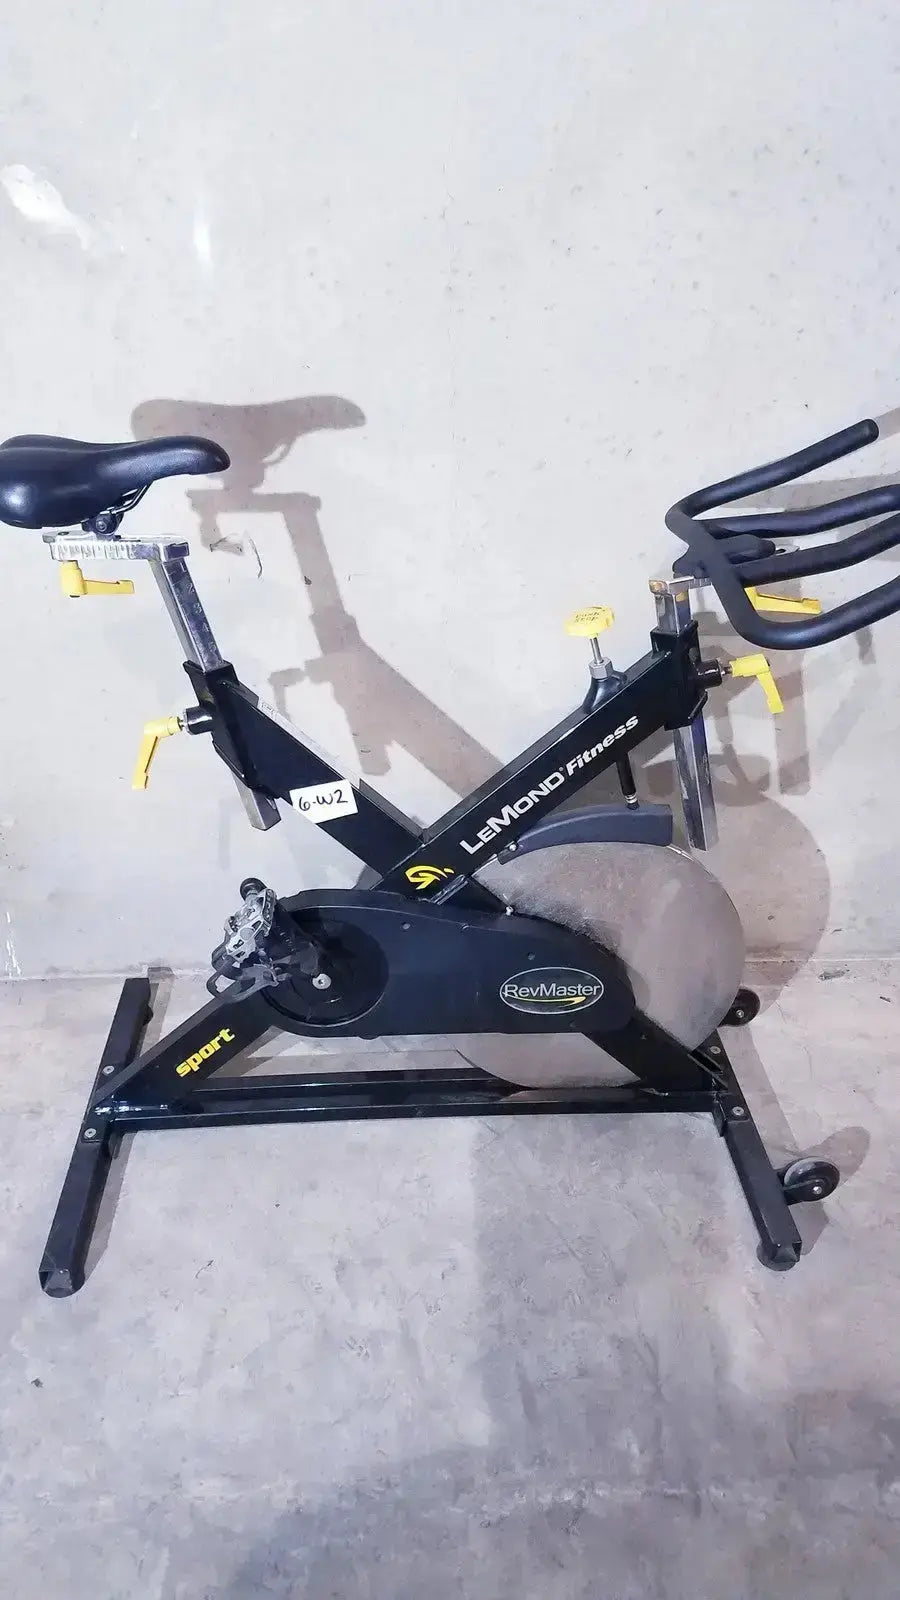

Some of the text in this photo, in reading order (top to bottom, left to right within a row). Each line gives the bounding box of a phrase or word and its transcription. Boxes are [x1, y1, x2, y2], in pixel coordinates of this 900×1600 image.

[565, 715, 640, 776] Fitness
[503, 983, 601, 998] RevMaster
[175, 1028, 236, 1078] sport
